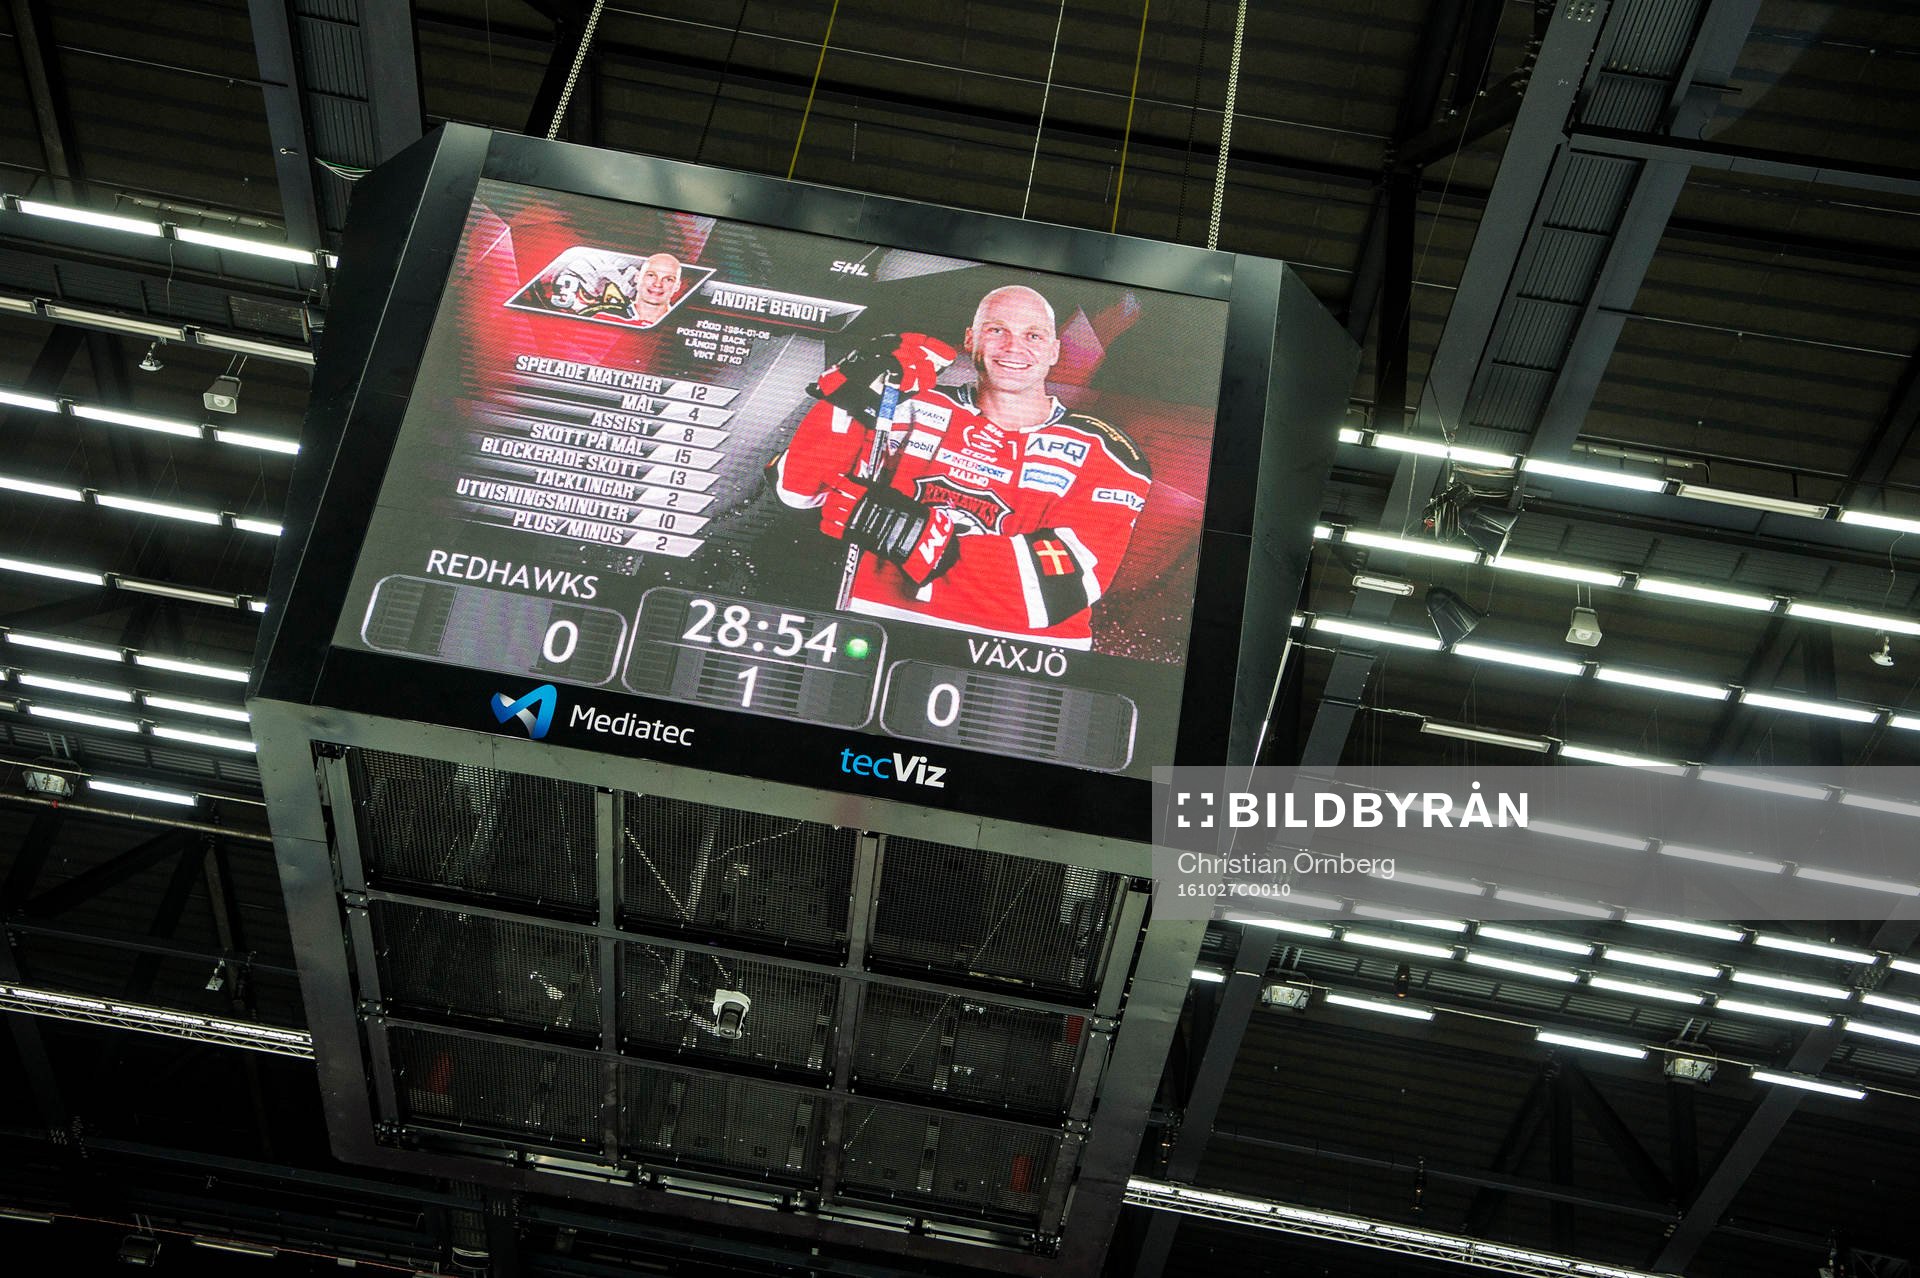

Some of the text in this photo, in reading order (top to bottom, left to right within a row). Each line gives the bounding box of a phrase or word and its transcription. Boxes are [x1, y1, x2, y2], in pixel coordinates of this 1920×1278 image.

[830, 260, 869, 277] SHL
[696, 320, 721, 331] FÖDD
[769, 300, 830, 323] BENOIT
[676, 327, 747, 346] POSITION BACK
[735, 347, 750, 357] CM
[693, 349, 715, 360] VIKT
[729, 355, 743, 365] KG
[516, 355, 707, 400] SPELADE MATCHER 12
[591, 412, 694, 442] ASSIST 8
[621, 393, 699, 422] MÅL 4
[480, 437, 686, 486] BLOCKERADE SKOTT 13
[530, 423, 692, 464] SKOTT PÅ MÅL 15
[1027, 437, 1087, 462] APQ
[951, 456, 1006, 479] INTERSPORT
[456, 478, 676, 529] UTVISNINGSMINUTER 10
[534, 469, 679, 506] TACKLINGAR 2
[512, 512, 668, 551] PLUS/MINUS 2
[425, 549, 599, 600] REDHAWKS
[542, 620, 579, 664] 0
[682, 599, 838, 663] 28:54
[966, 638, 1068, 678] VÄXJÖ
[737, 665, 759, 708] 1
[926, 683, 961, 728] 0
[569, 704, 695, 747] Mediatec
[840, 747, 948, 789] tecViz
